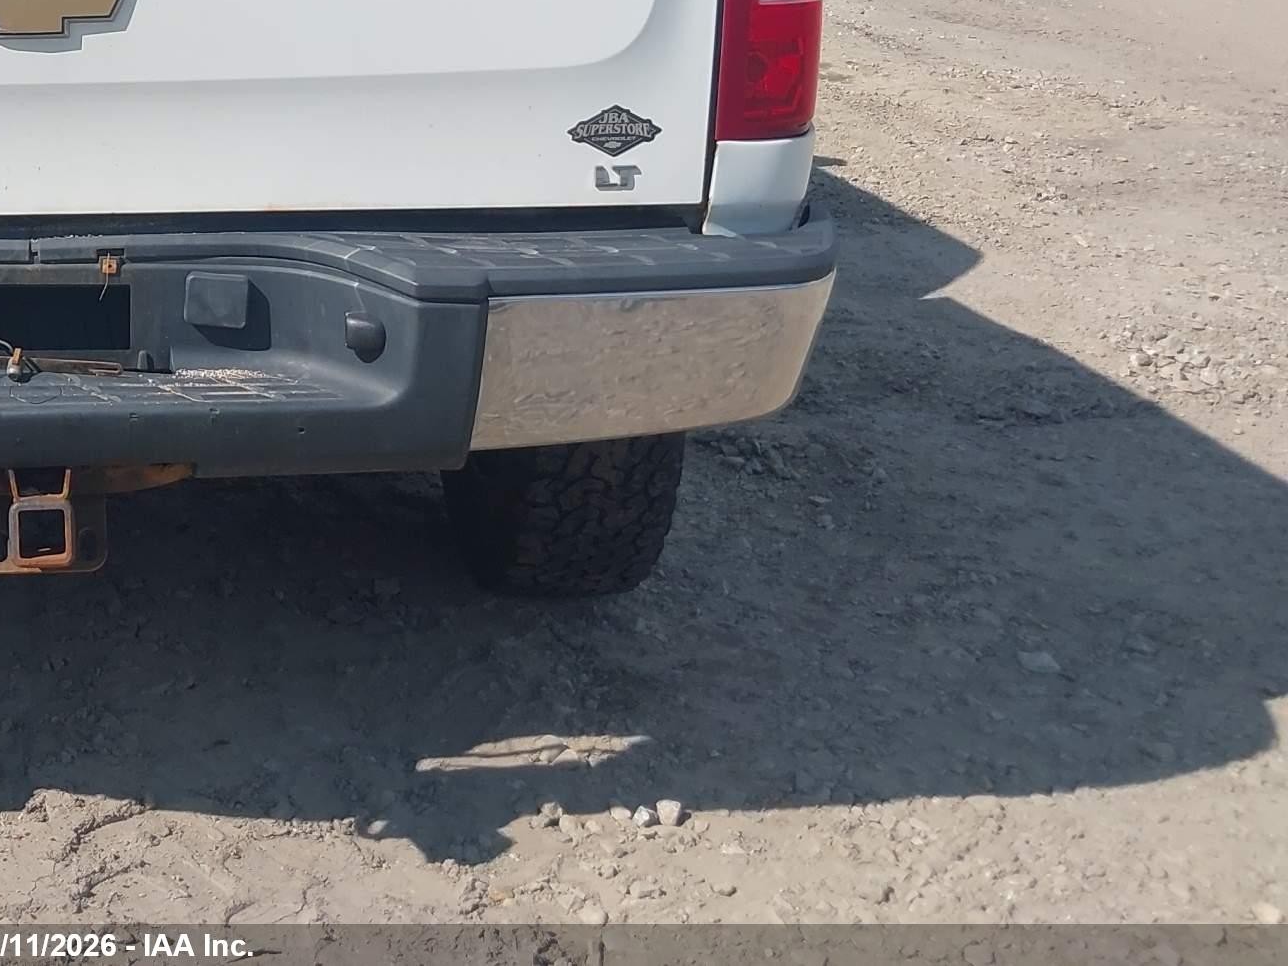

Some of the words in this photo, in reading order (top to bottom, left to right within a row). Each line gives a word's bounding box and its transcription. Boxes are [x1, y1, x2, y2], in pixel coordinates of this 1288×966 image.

[599, 112, 630, 124] JBA
[574, 122, 652, 139] SUPERSTORE
[595, 164, 642, 191] LT
